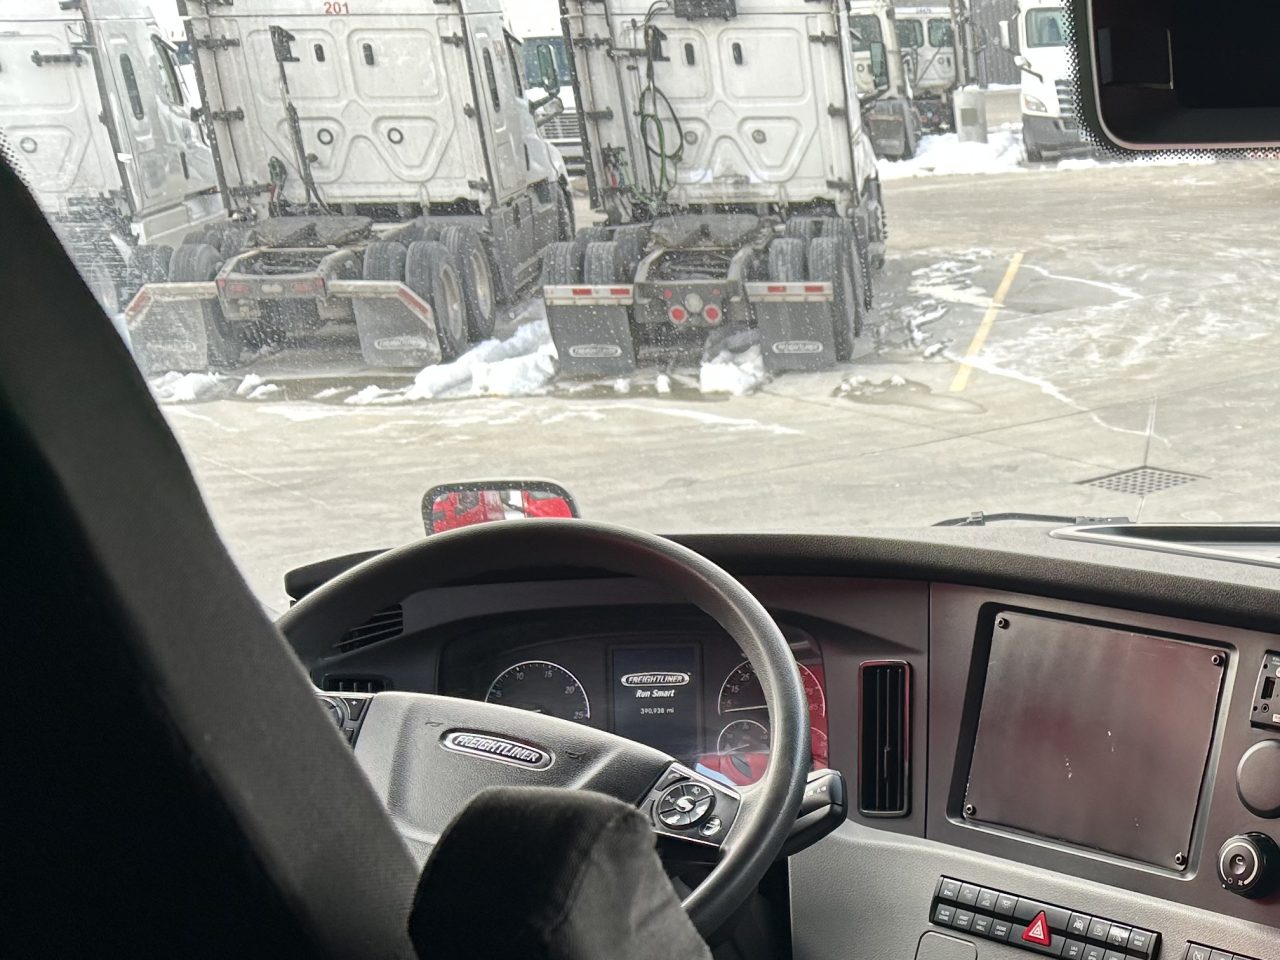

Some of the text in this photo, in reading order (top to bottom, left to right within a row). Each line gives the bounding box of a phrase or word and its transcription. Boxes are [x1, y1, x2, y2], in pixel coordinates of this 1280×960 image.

[324, 1, 350, 15] 201
[515, 672, 525, 681] 10
[544, 671, 553, 679] 15
[628, 675, 683, 684] FREIGHTLINER
[564, 686, 576, 695] 20
[635, 689, 675, 698] Run Smart
[573, 711, 585, 720] 25
[454, 735, 540, 762] FREIGHTLINER
